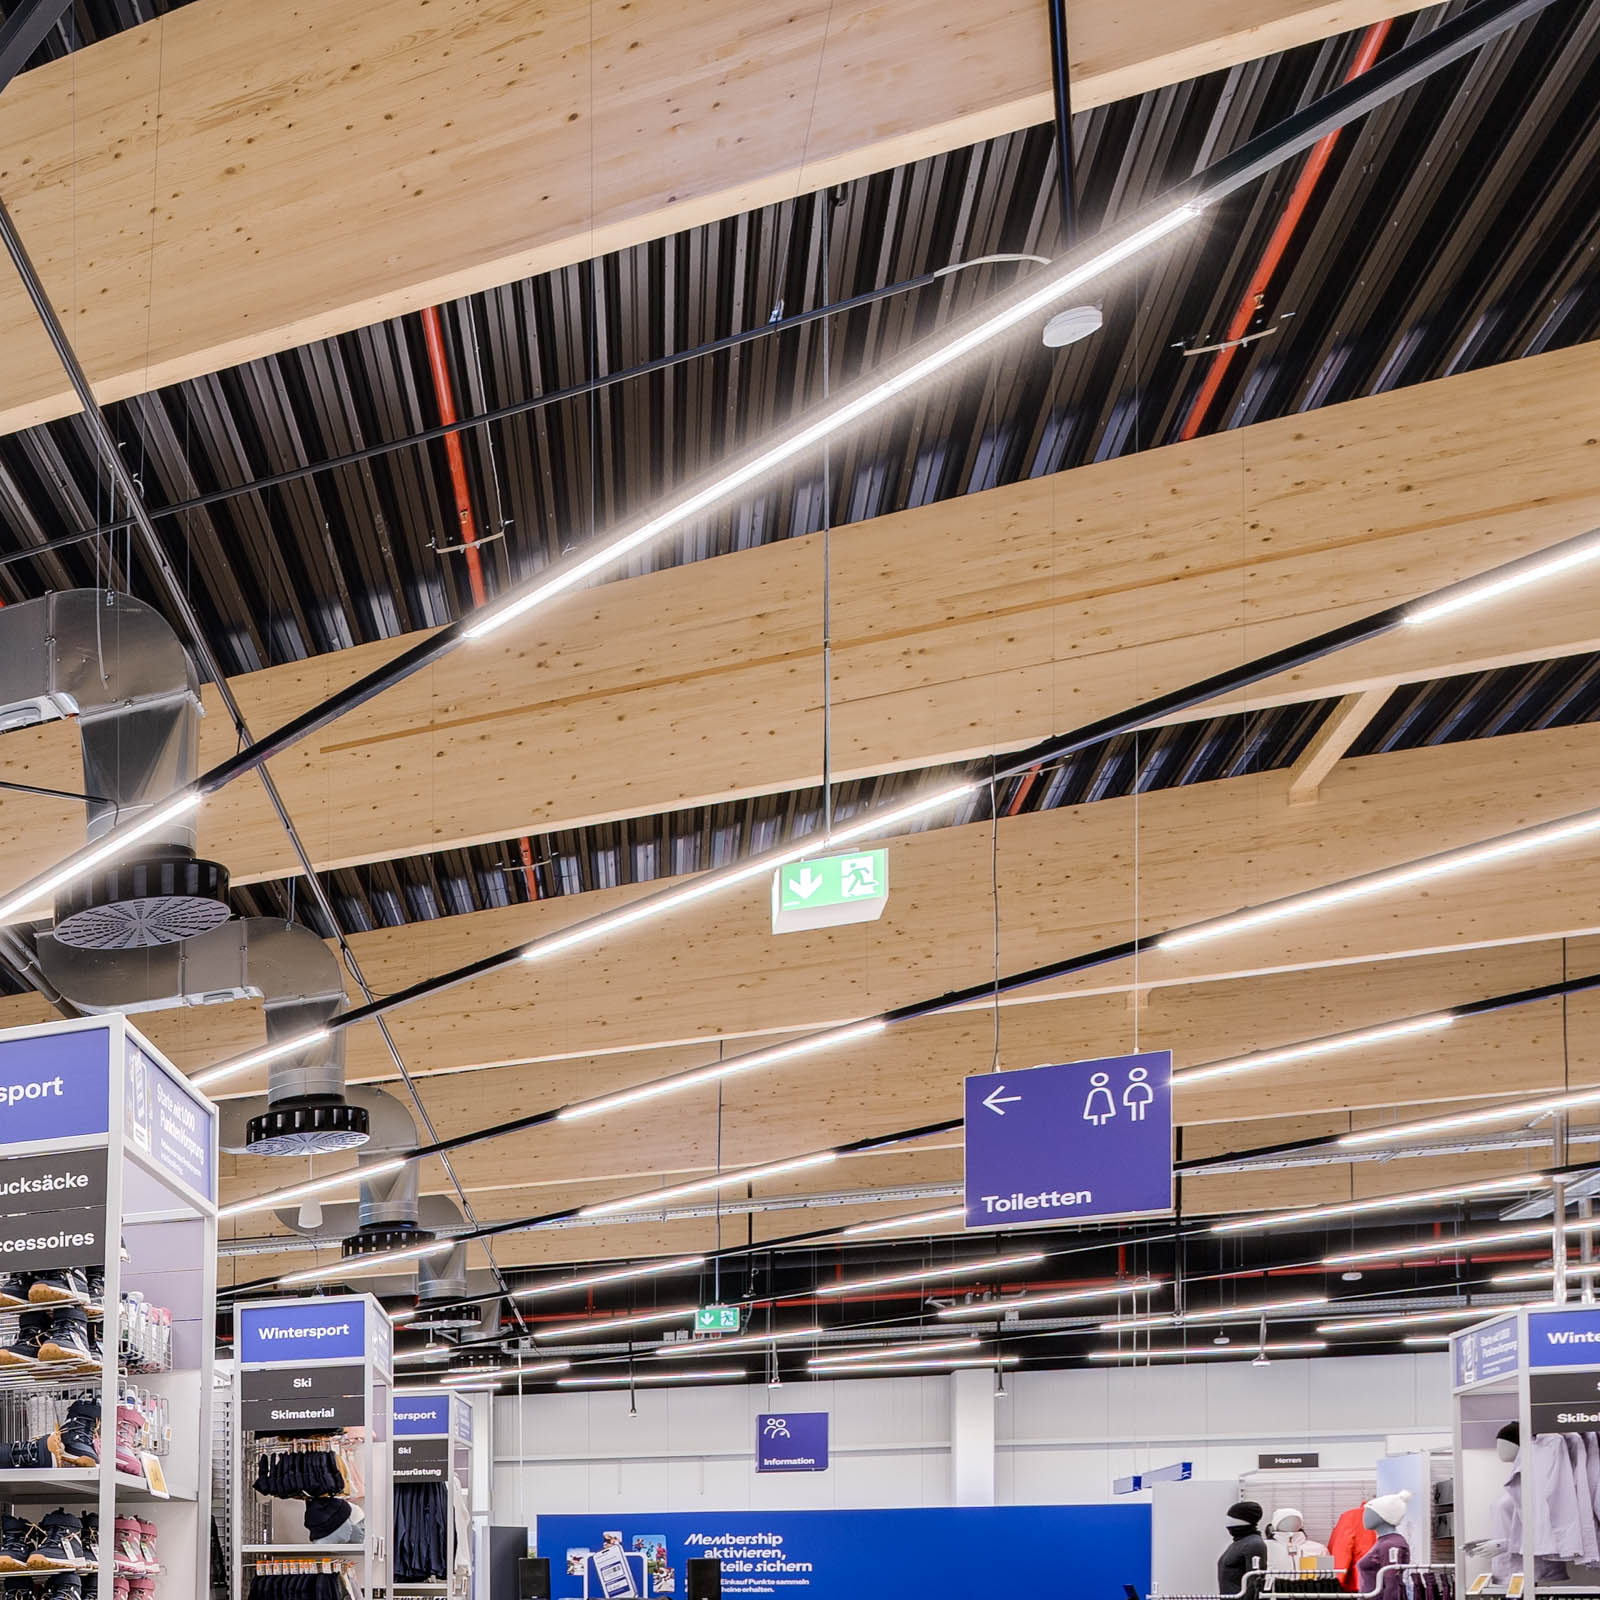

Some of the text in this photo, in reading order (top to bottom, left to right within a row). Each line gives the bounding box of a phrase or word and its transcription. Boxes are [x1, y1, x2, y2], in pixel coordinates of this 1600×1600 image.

[981, 1190, 1092, 1213] Toiletten
[258, 1324, 350, 1340] Wintersport
[293, 1377, 312, 1388] Ski
[271, 1408, 334, 1420] Skimaterial
[393, 1411, 437, 1422] tersport
[764, 1457, 815, 1466] Information
[393, 1467, 441, 1477] zausrüstung
[684, 1533, 783, 1547] Membership
[704, 1547, 786, 1560] aktivieren,
[720, 1561, 812, 1572] teile sichern
